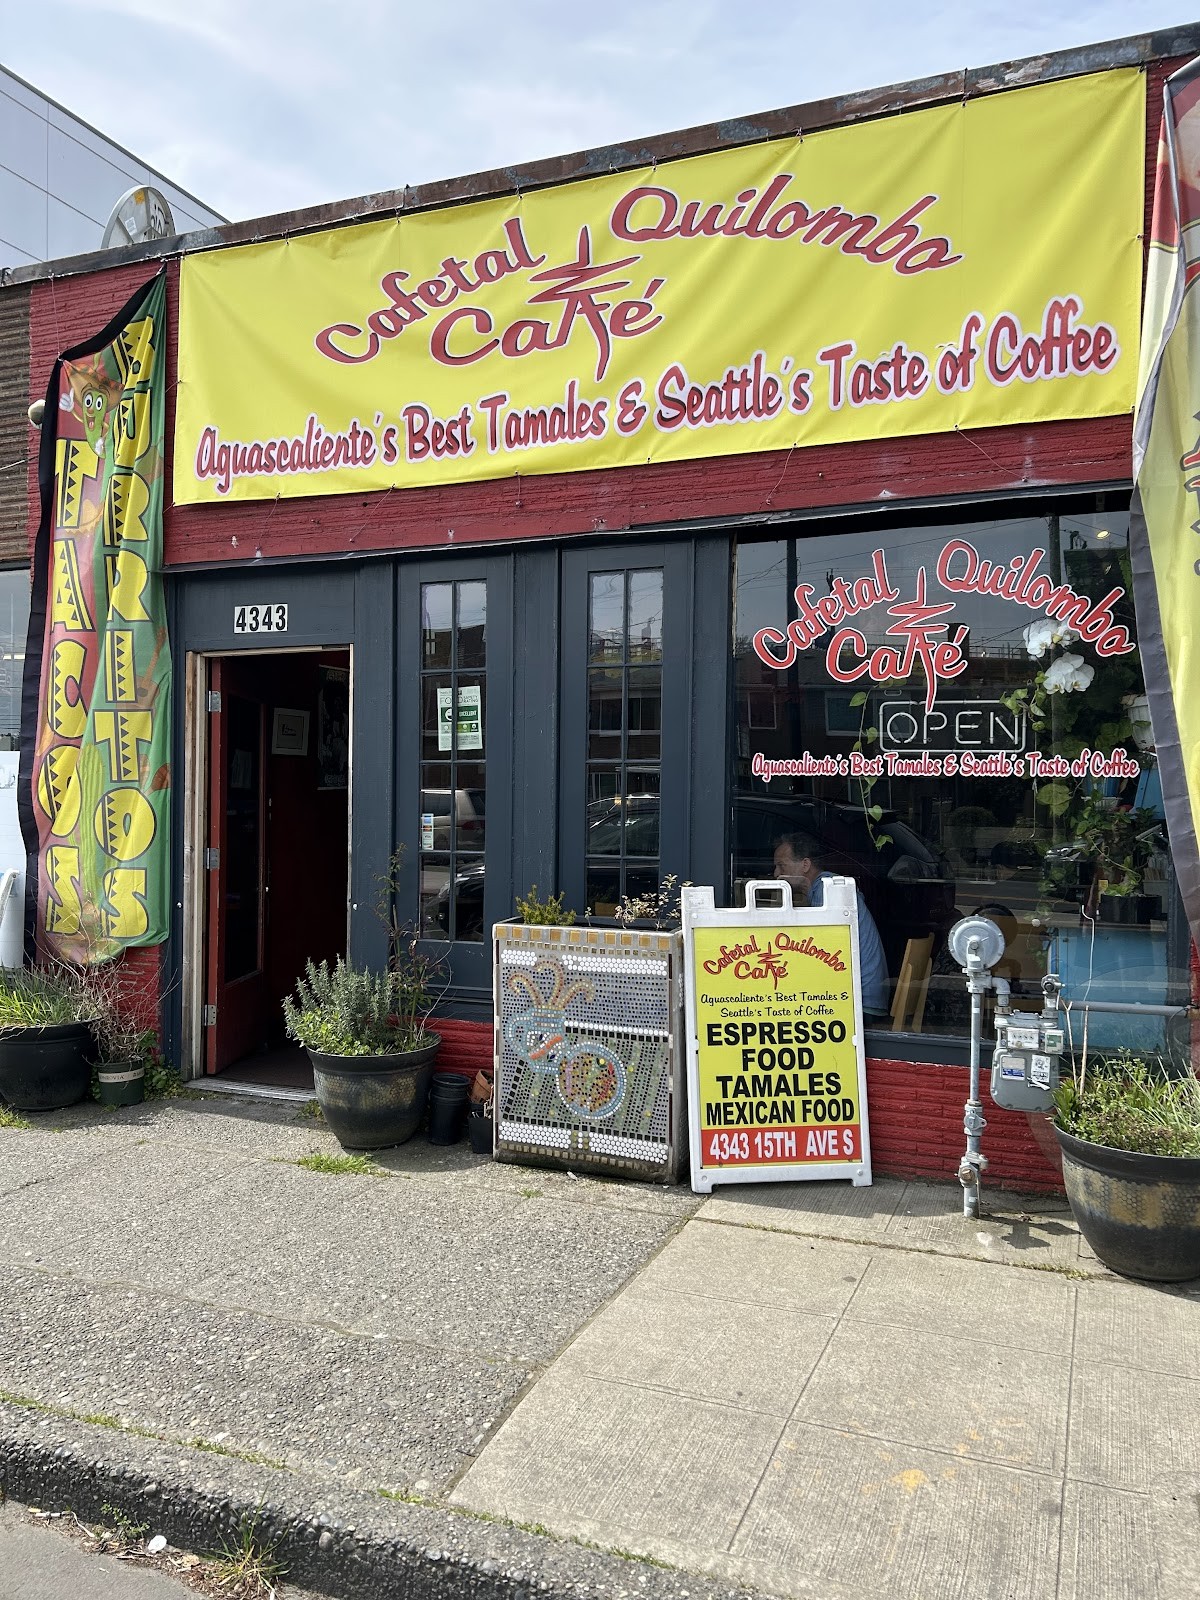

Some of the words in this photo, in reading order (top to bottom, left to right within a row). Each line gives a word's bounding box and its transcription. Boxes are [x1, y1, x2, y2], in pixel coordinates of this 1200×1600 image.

[315, 217, 546, 365] Cafetal
[610, 174, 964, 276] Quilombo
[430, 277, 665, 382] Café
[195, 411, 398, 496] Aguascaliente's
[403, 401, 475, 463] Best
[478, 380, 608, 453] Tamales
[615, 377, 646, 437] &
[654, 350, 811, 431] Seattle's
[817, 341, 928, 411] Taste
[936, 311, 985, 396] of
[985, 294, 1120, 388] Coffee
[235, 605, 287, 632] 4343
[753, 548, 899, 670] Cafetal
[936, 538, 1136, 658] Quilombo
[825, 625, 970, 714] Café
[38, 437, 99, 936] TACOS
[886, 709, 1021, 746] OPEN
[752, 751, 849, 782] Aguascaliente's
[850, 752, 882, 778] Best
[883, 751, 942, 777] Tamales
[943, 753, 957, 777] &
[960, 751, 1024, 777] Seattle's
[1026, 752, 1069, 778] Taste
[1071, 748, 1090, 778] of
[1090, 748, 1140, 778] Coffee
[703, 935, 761, 976] Cafetal
[774, 932, 847, 973] Quilombo
[734, 961, 789, 990] Café
[701, 993, 772, 1006] Aguascaliente's
[775, 991, 797, 1002] Best
[799, 991, 838, 1002] Tamales
[840, 991, 849, 1001] &
[720, 1006, 762, 1018] Seattle's
[764, 1007, 791, 1017] Taste
[793, 1005, 804, 1017] of
[805, 1004, 834, 1016] Coffee
[706, 1020, 846, 1047] ESPRESSO
[742, 1047, 815, 1072] FOOD
[716, 1072, 841, 1099] TAMALES
[706, 1100, 796, 1126] MEXICAN
[802, 1098, 855, 1123] FOOD
[710, 1132, 749, 1160] 4343
[754, 1130, 797, 1159] 15TH
[806, 1129, 838, 1157] AVE
[842, 1129, 854, 1156] S
